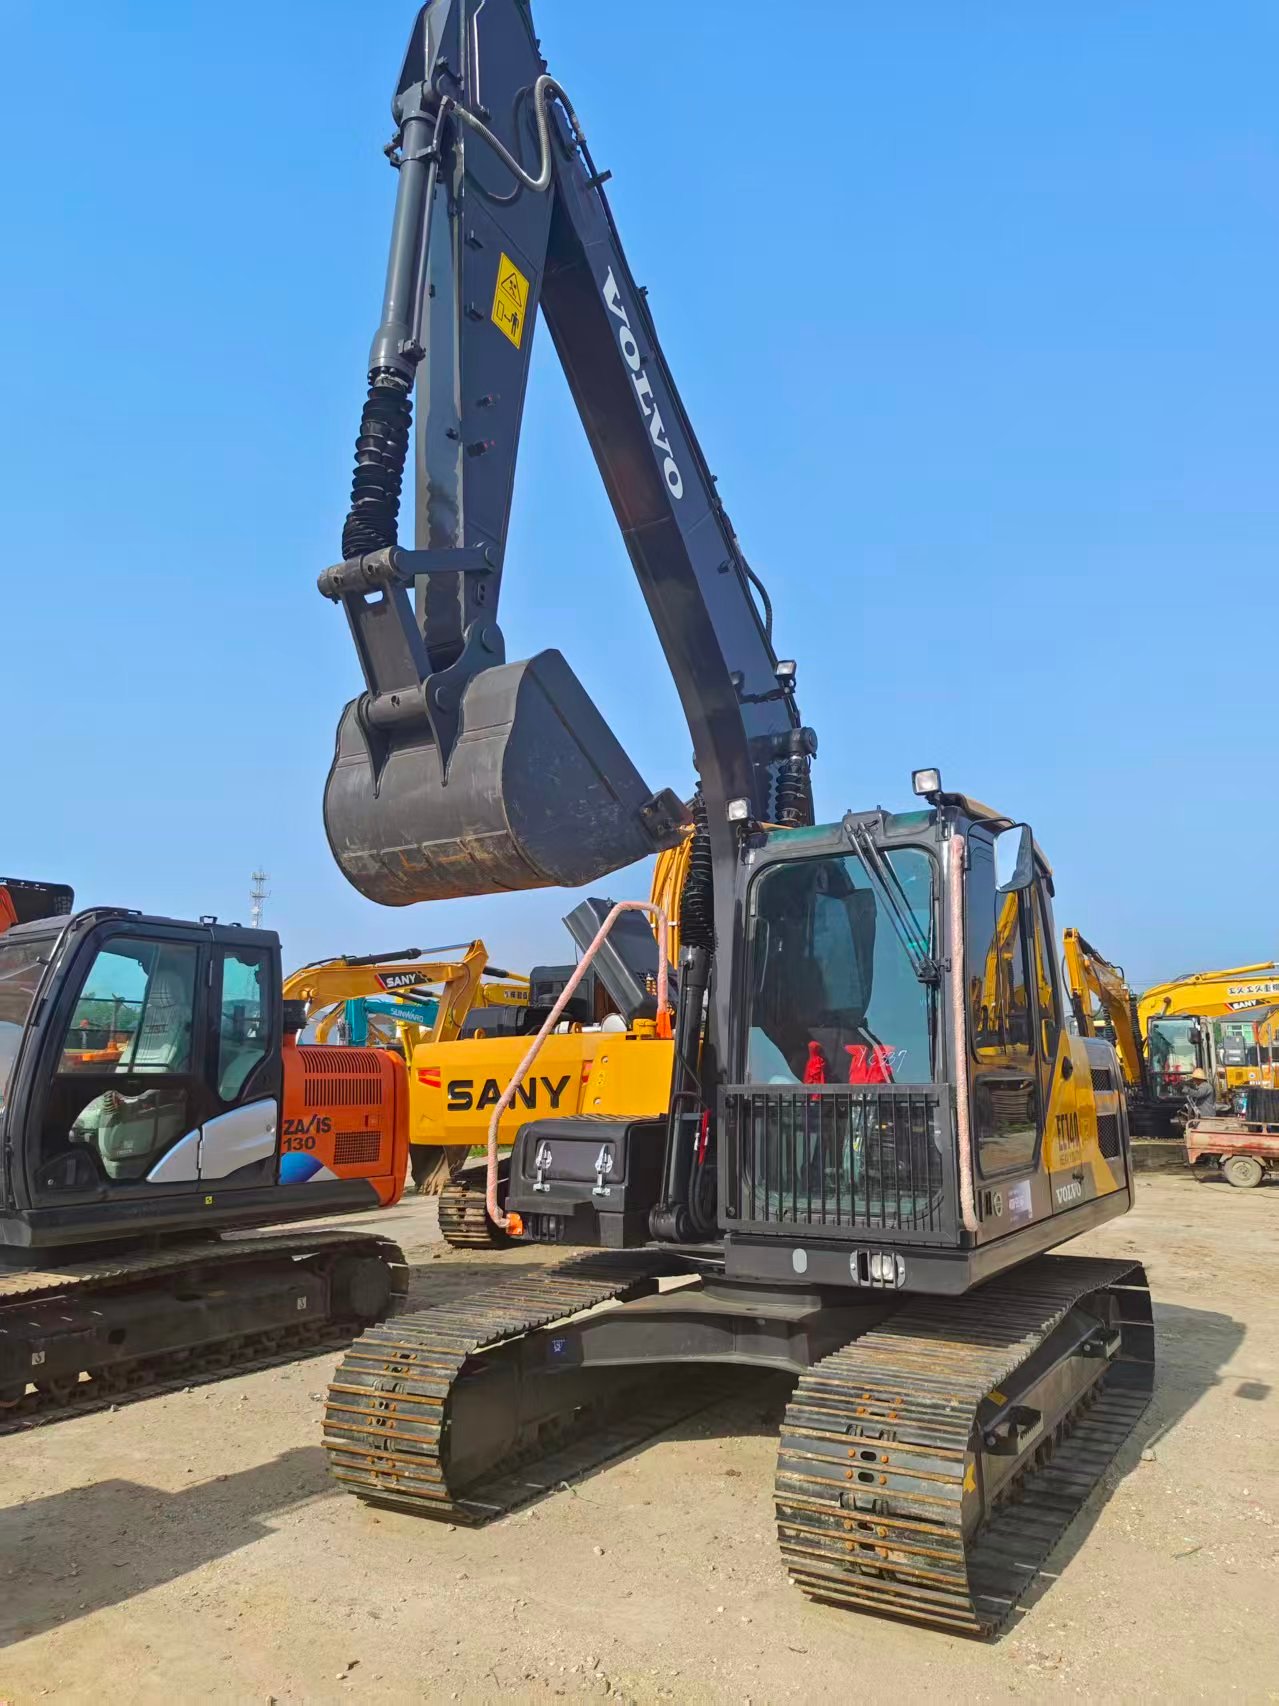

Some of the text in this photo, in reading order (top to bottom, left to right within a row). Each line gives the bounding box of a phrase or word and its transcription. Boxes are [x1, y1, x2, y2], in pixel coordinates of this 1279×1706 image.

[602, 266, 684, 500] VOLVO
[386, 974, 416, 988] SANY
[1232, 999, 1257, 1010] SANY
[391, 1008, 424, 1022] SUNWARD
[447, 1075, 571, 1111] SANY
[283, 1136, 316, 1151] 130
[1056, 1182, 1082, 1204] VOLVO
